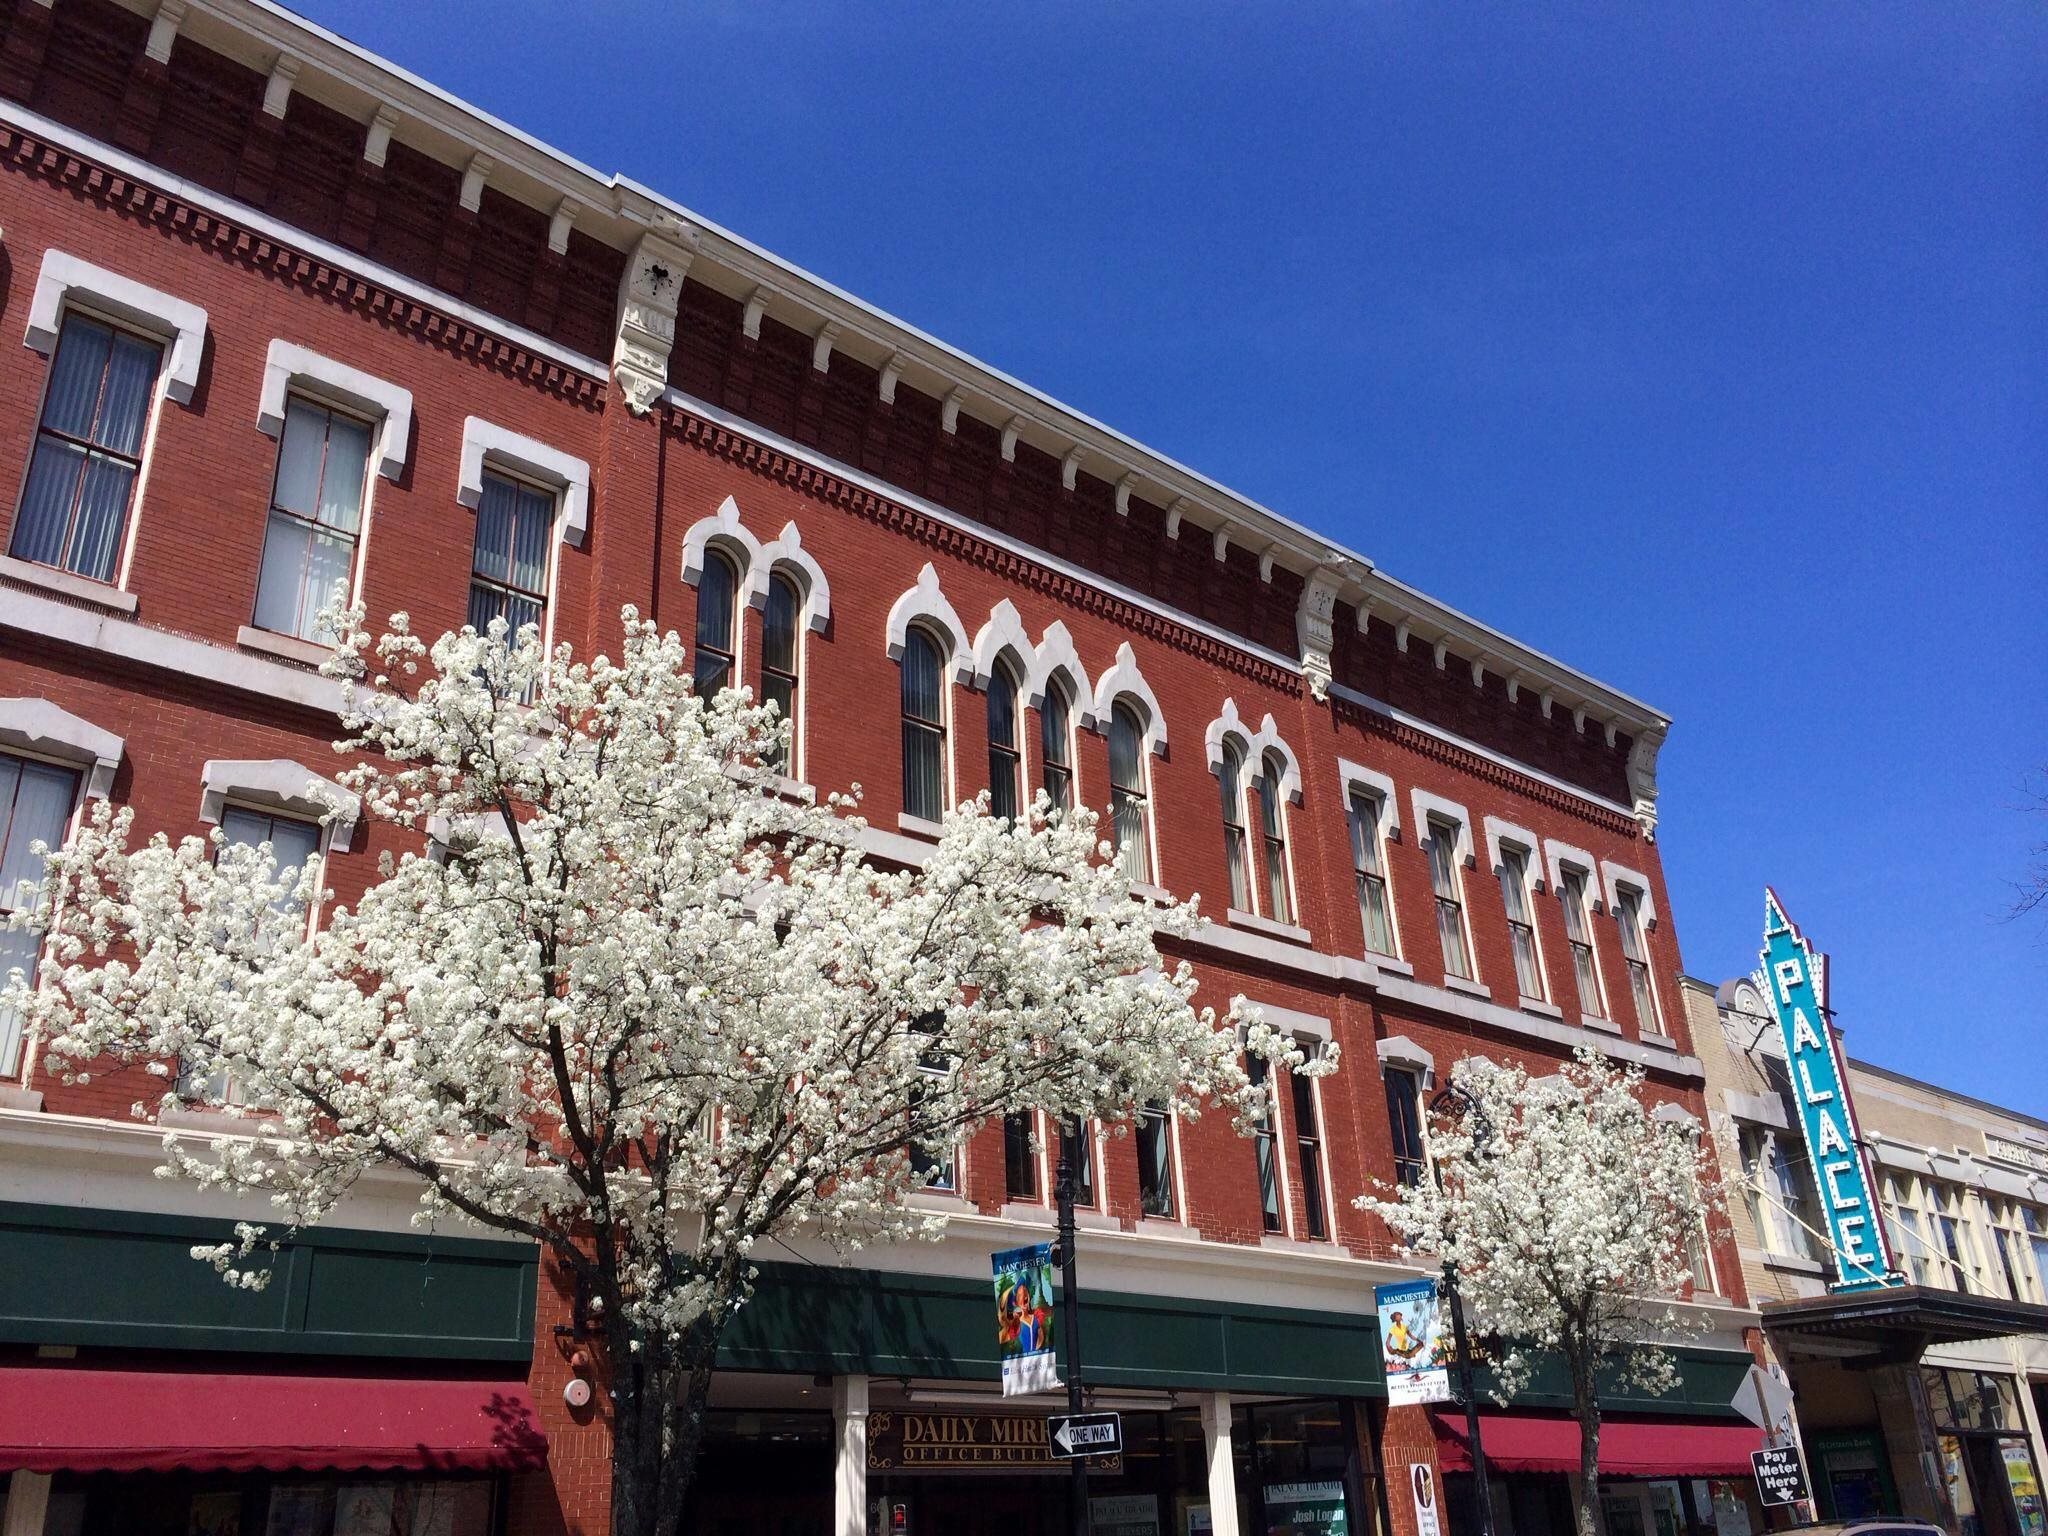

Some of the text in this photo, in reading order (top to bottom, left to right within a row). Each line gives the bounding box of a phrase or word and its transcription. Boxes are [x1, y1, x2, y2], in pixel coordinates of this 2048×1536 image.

[1773, 958, 1875, 1265] PALACE
[999, 1257, 1046, 1273] MANCHESTER
[1383, 1290, 1431, 1304] MANCHESTER
[903, 1416, 1050, 1444] DAILY MIRR
[1069, 1424, 1112, 1443] ONE WAY
[903, 1447, 982, 1461] OFFICE
[1763, 1451, 1787, 1464] Pay
[1758, 1462, 1798, 1477] Meter
[1765, 1475, 1799, 1489] Here
[1293, 1509, 1344, 1523] Josh Logan
